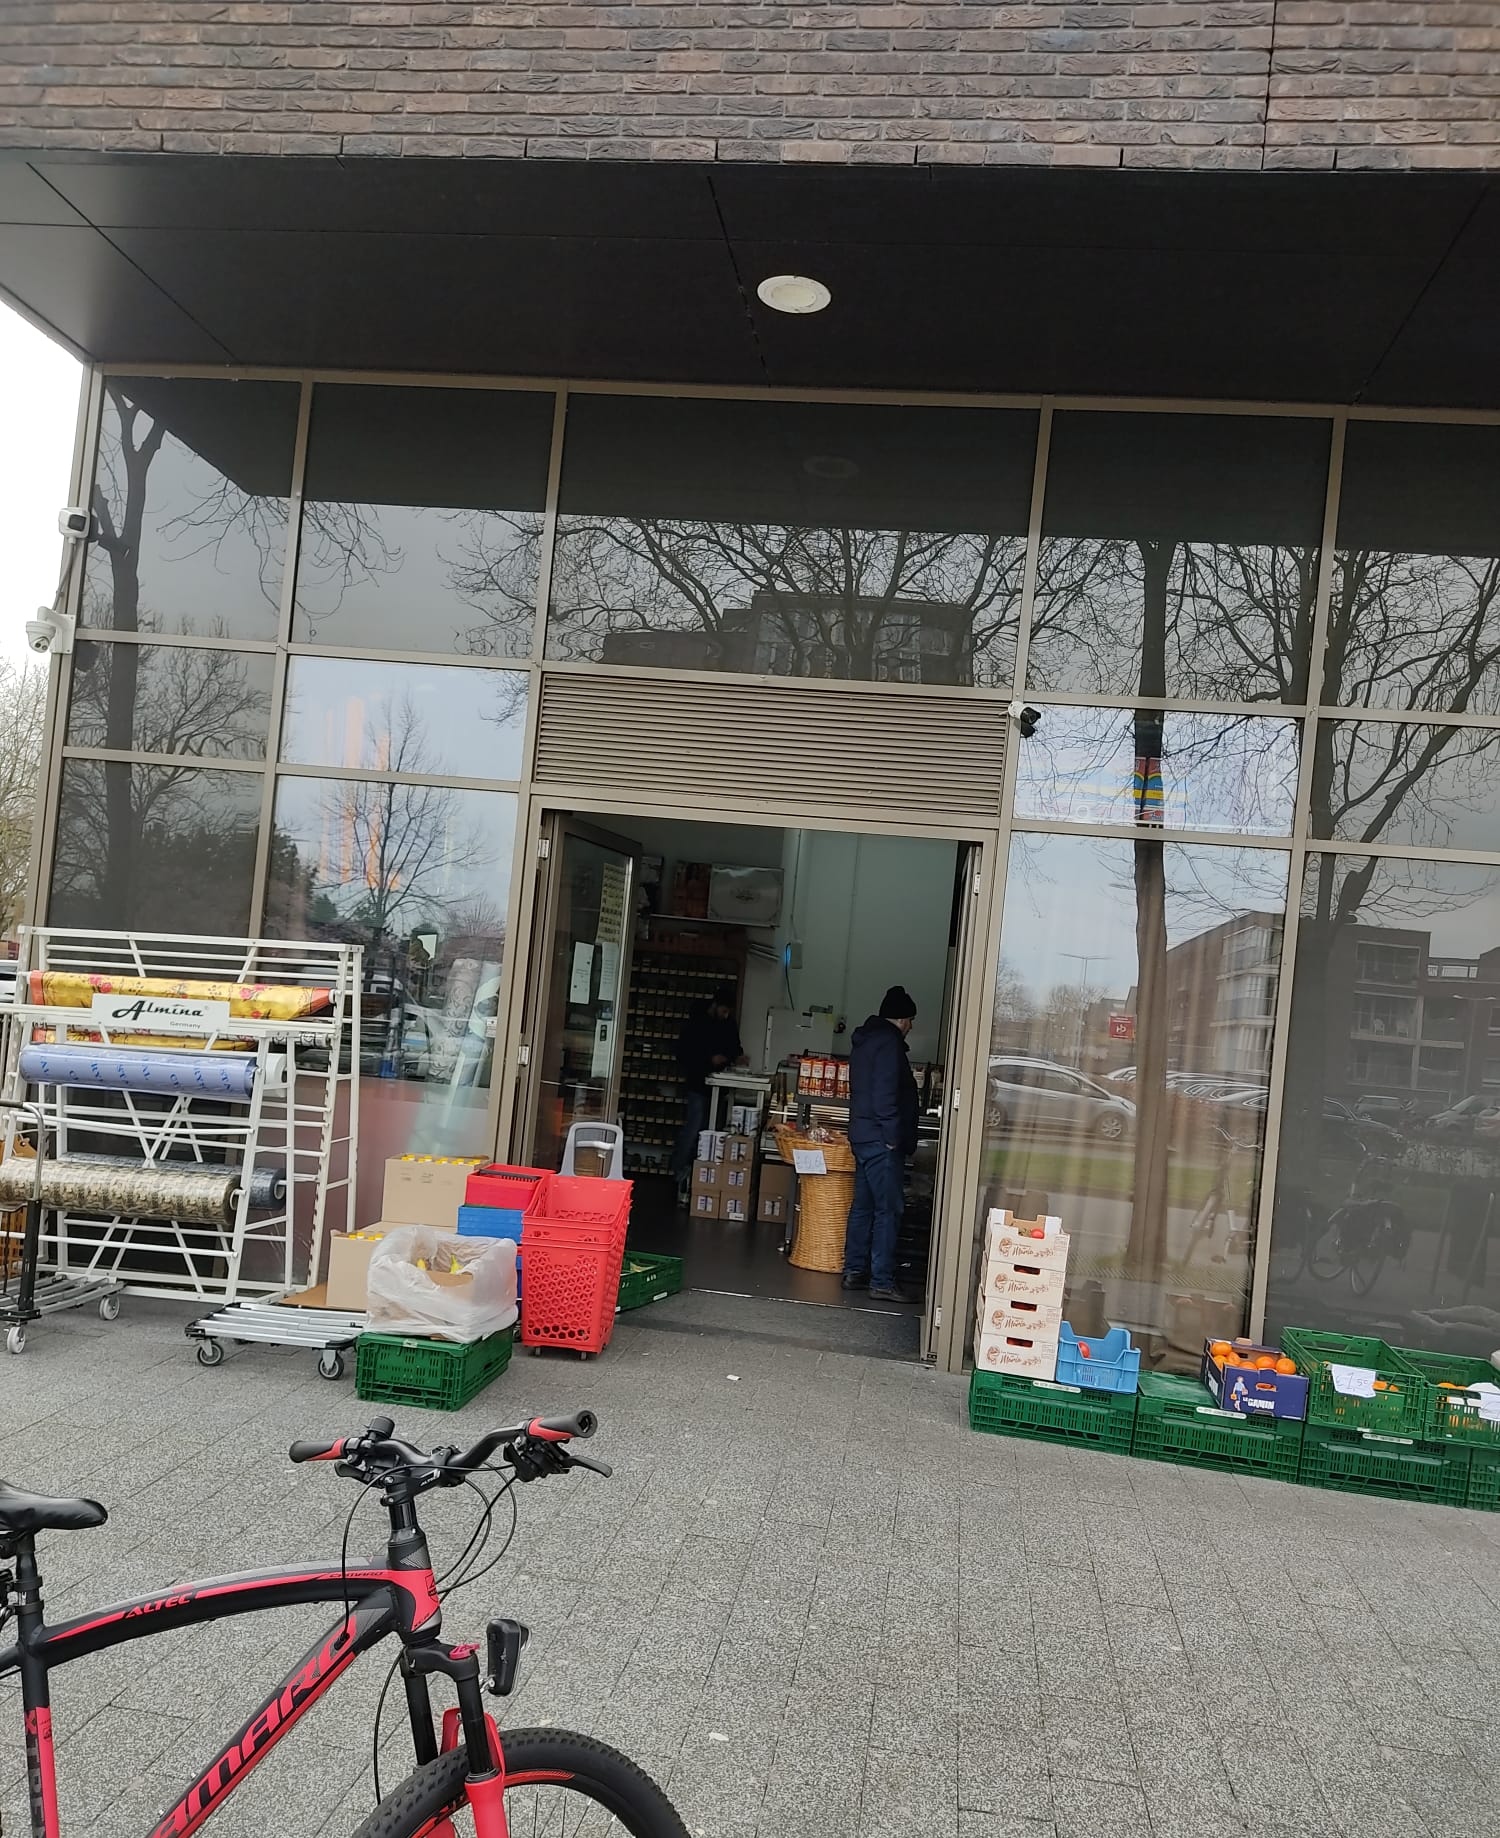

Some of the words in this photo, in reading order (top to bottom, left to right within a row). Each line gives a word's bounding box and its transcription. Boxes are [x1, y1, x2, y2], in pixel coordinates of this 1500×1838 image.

[112, 1000, 204, 1021] Almina
[170, 1021, 200, 1029] Germany
[125, 1592, 193, 1619] ALTEC
